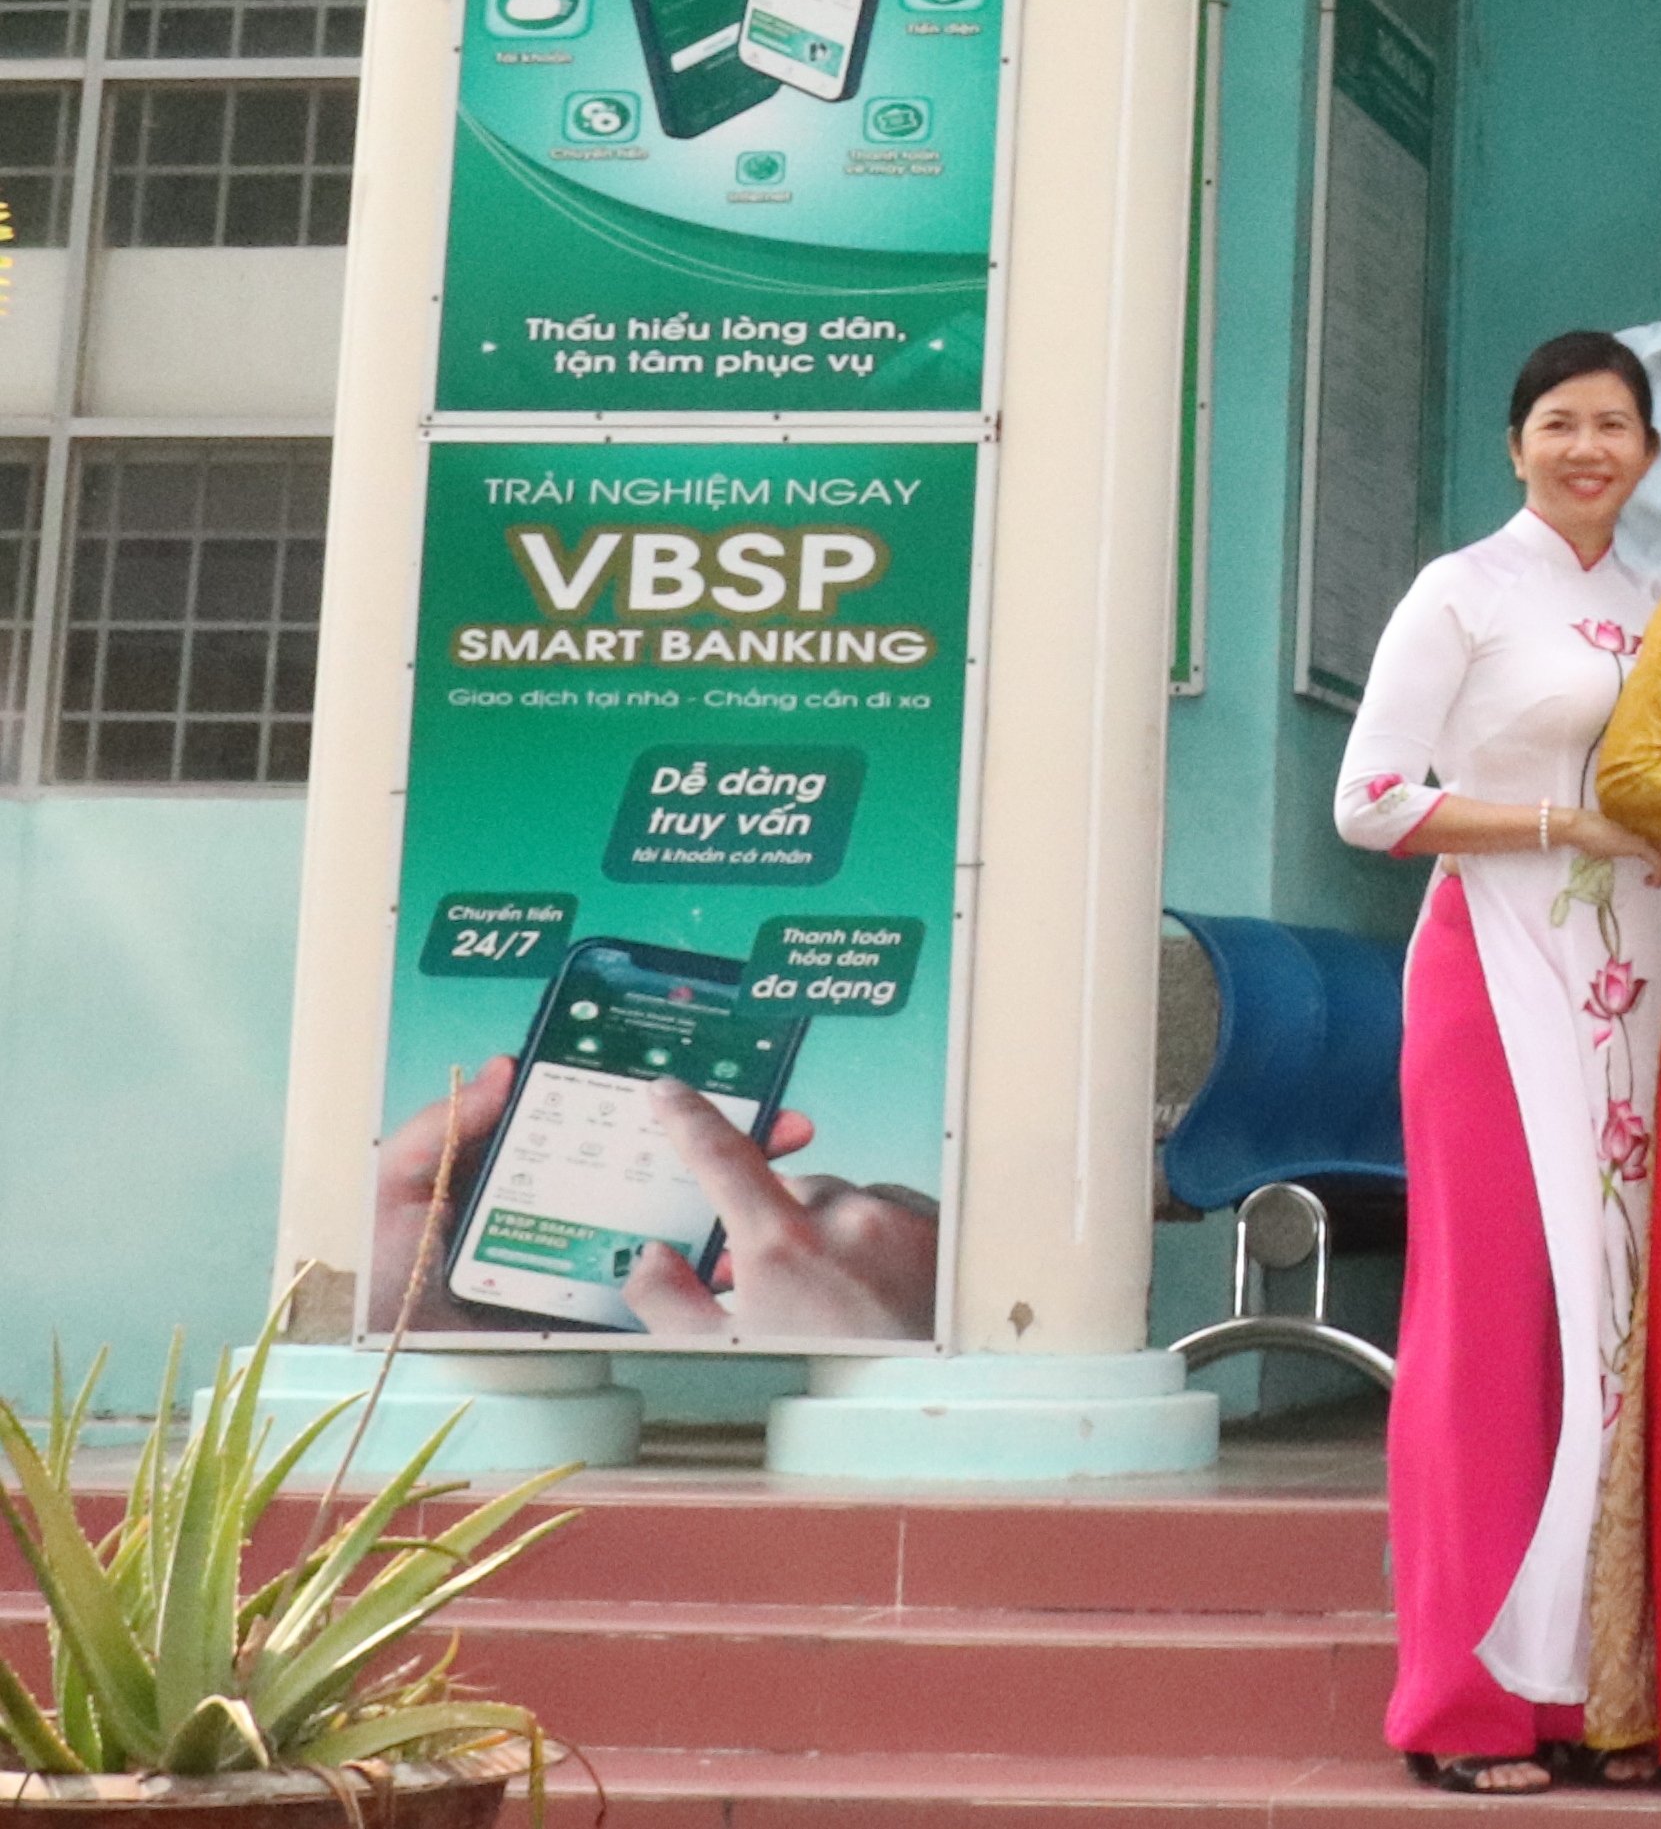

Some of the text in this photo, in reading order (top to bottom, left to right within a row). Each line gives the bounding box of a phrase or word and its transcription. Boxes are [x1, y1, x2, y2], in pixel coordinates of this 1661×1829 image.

[526, 313, 616, 341] Thấu
[628, 311, 710, 341] hiểu
[722, 316, 807, 345] lòng
[628, 350, 704, 374] tâm
[715, 350, 815, 378] phục
[828, 353, 874, 378] vụ
[484, 471, 922, 511] TRẢI NGHIỆM NGAY
[519, 533, 876, 612] VBSP
[458, 628, 929, 663] SMART BANKING
[448, 689, 513, 708] Giao
[520, 689, 578, 710] dịch
[899, 695, 931, 711] xa
[651, 761, 827, 803] Dễ dàng
[647, 803, 812, 841] truy vấn
[451, 929, 541, 961] 24/7
[781, 927, 847, 947] Thanh
[751, 975, 897, 1006] đa dạng
